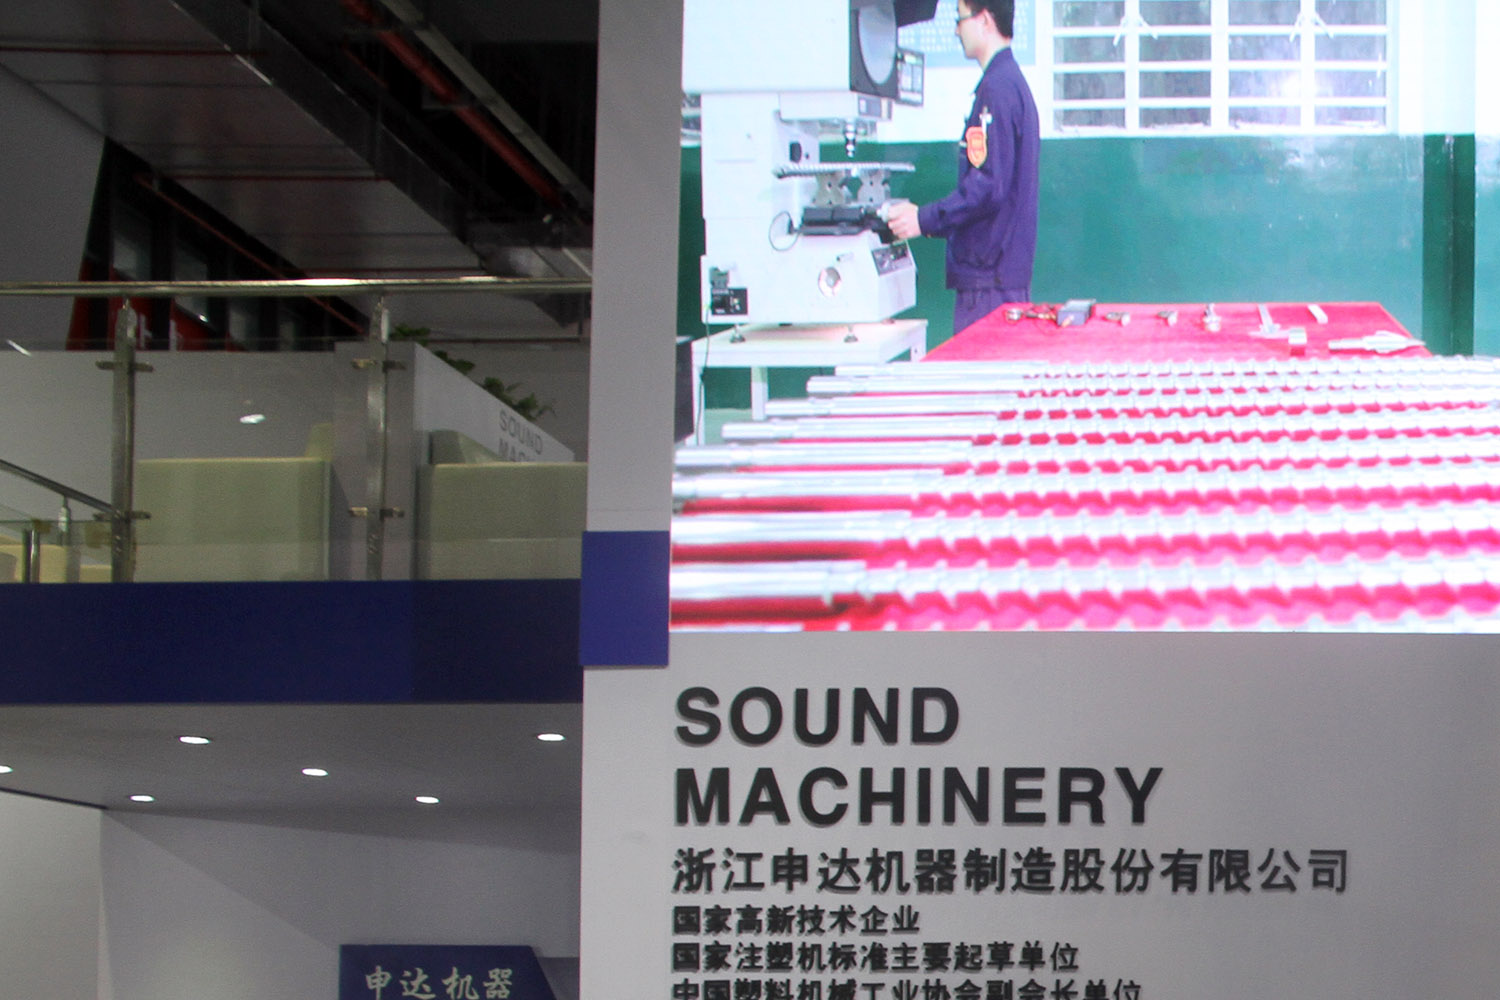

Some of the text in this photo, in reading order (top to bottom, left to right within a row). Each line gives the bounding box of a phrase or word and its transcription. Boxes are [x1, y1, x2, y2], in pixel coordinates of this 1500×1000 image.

[675, 686, 960, 747] SOUND
[675, 766, 1163, 826] MACHINERY
[672, 846, 1350, 894] 浙江申达机器制造股份有限公司
[672, 905, 920, 935] 国家高新技术企业
[672, 942, 1080, 973] 国家注塑机标准主要起草单位
